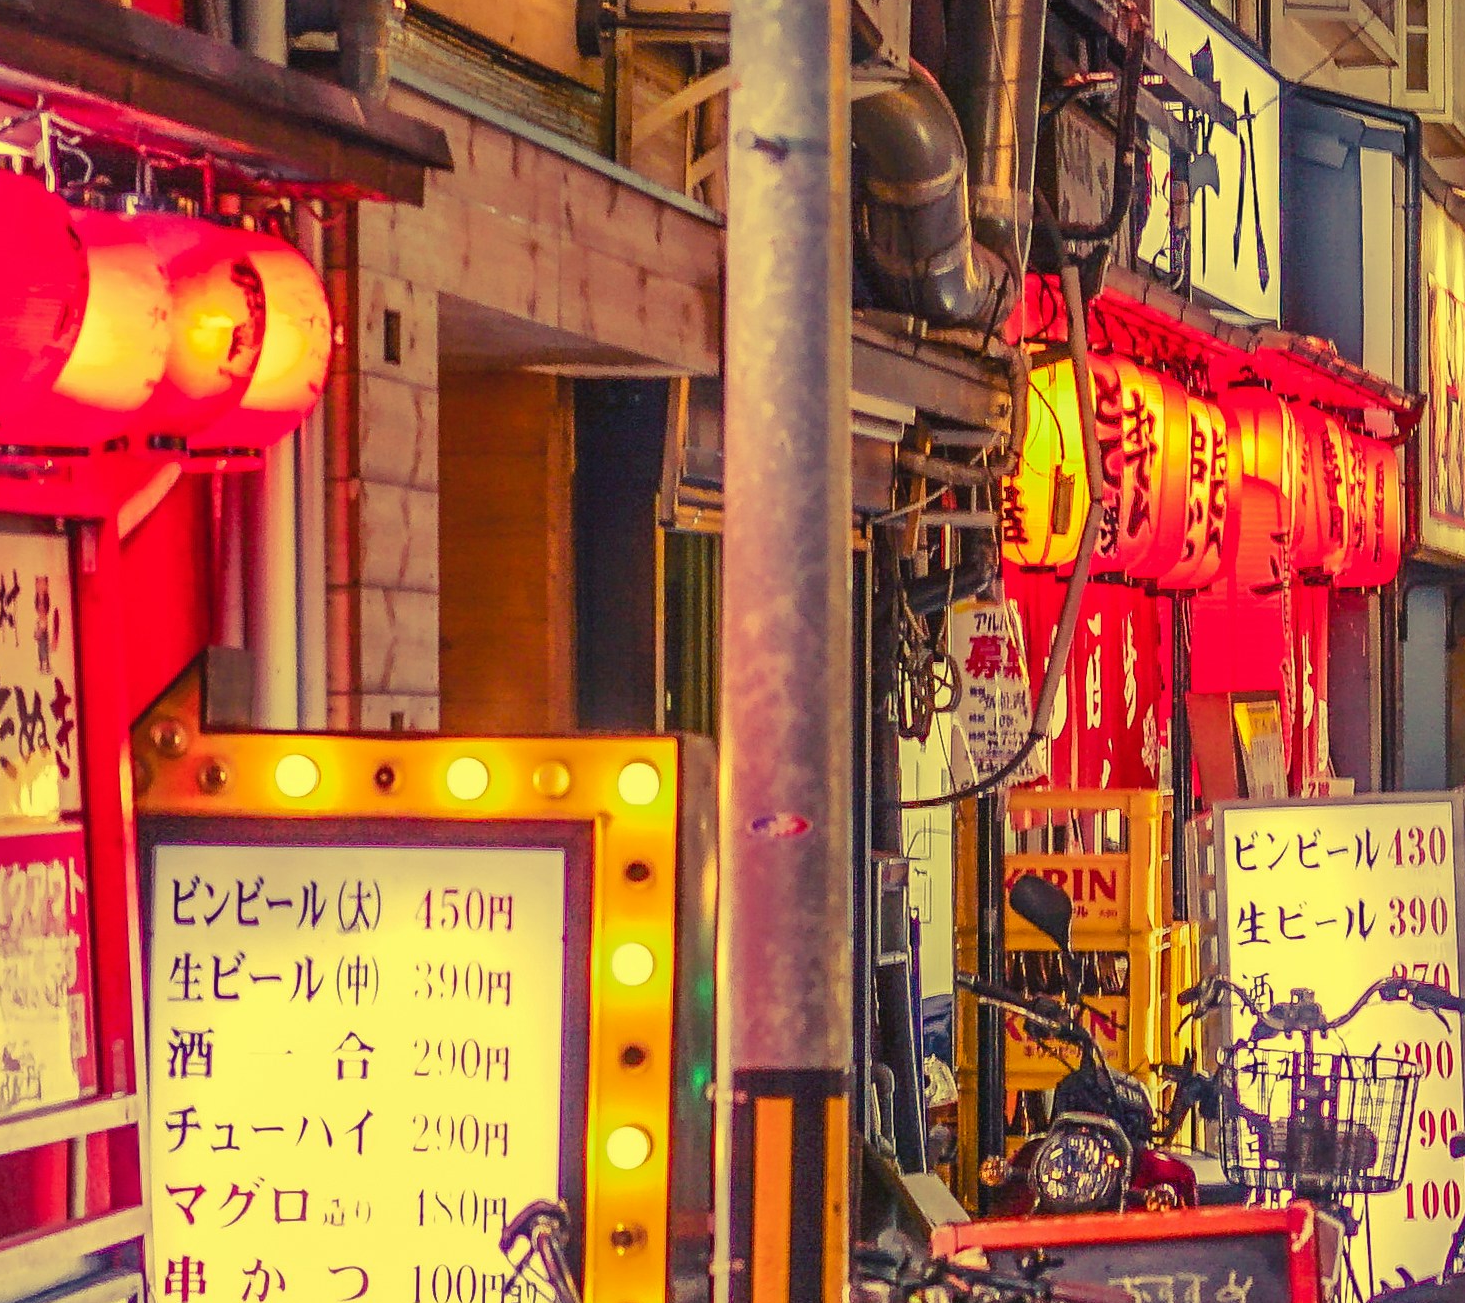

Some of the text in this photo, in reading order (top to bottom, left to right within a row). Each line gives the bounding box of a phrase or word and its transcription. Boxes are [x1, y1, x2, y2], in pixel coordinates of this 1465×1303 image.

[1234, 825, 1447, 873] ビンビール 430
[415, 886, 514, 933] 450円
[1236, 897, 1449, 947] 生ビール 390
[414, 960, 512, 1007] 390円
[413, 1036, 511, 1083] 290円
[165, 1106, 509, 1160] チューハイ 290円
[1404, 1180, 1462, 1221] 100
